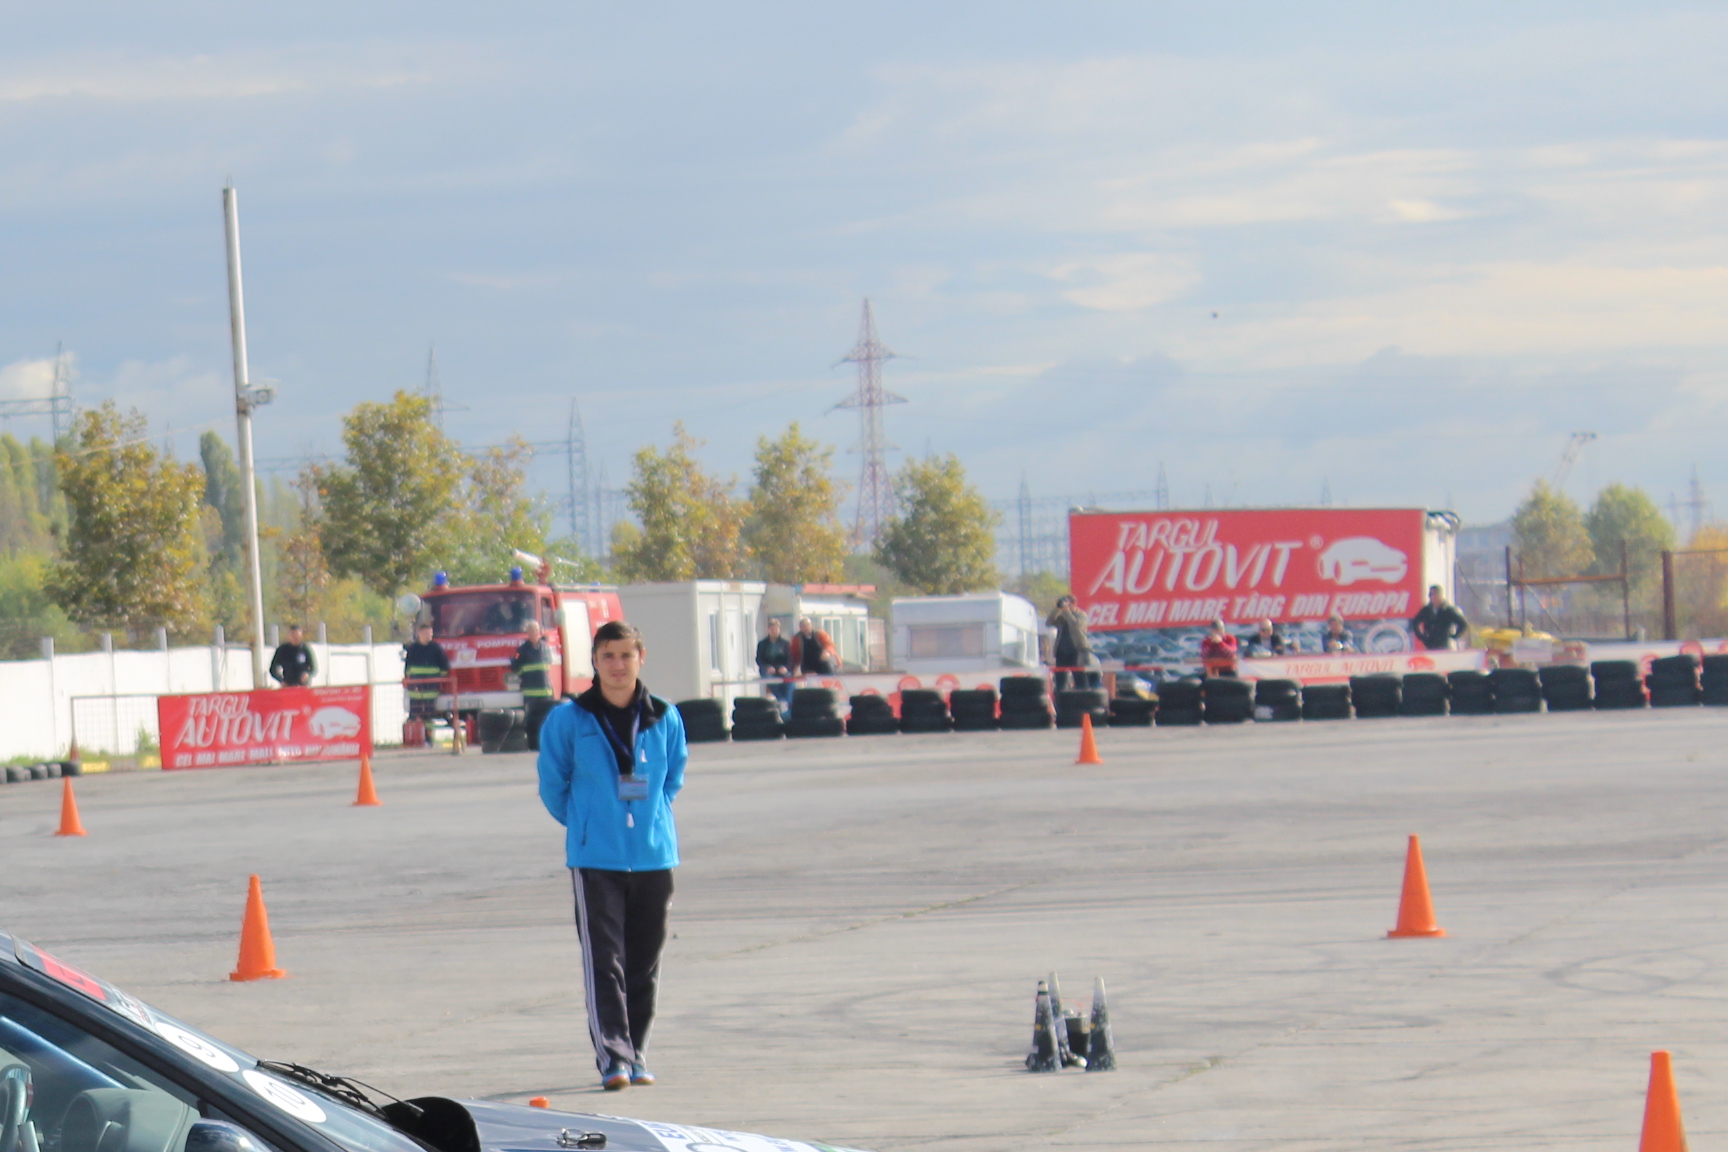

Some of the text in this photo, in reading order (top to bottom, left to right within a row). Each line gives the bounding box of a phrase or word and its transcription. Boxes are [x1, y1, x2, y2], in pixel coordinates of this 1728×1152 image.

[1118, 518, 1219, 550] TARGUL
[1090, 540, 1303, 596] AUTOVIT
[1087, 604, 1119, 627] CEL
[1125, 601, 1168, 624] MAI
[1172, 599, 1227, 623] MARE
[1290, 594, 1328, 617] DIN
[1332, 591, 1410, 616] EUROPA
[189, 695, 250, 718] TARGUL
[175, 709, 300, 749] AUTOVIT
